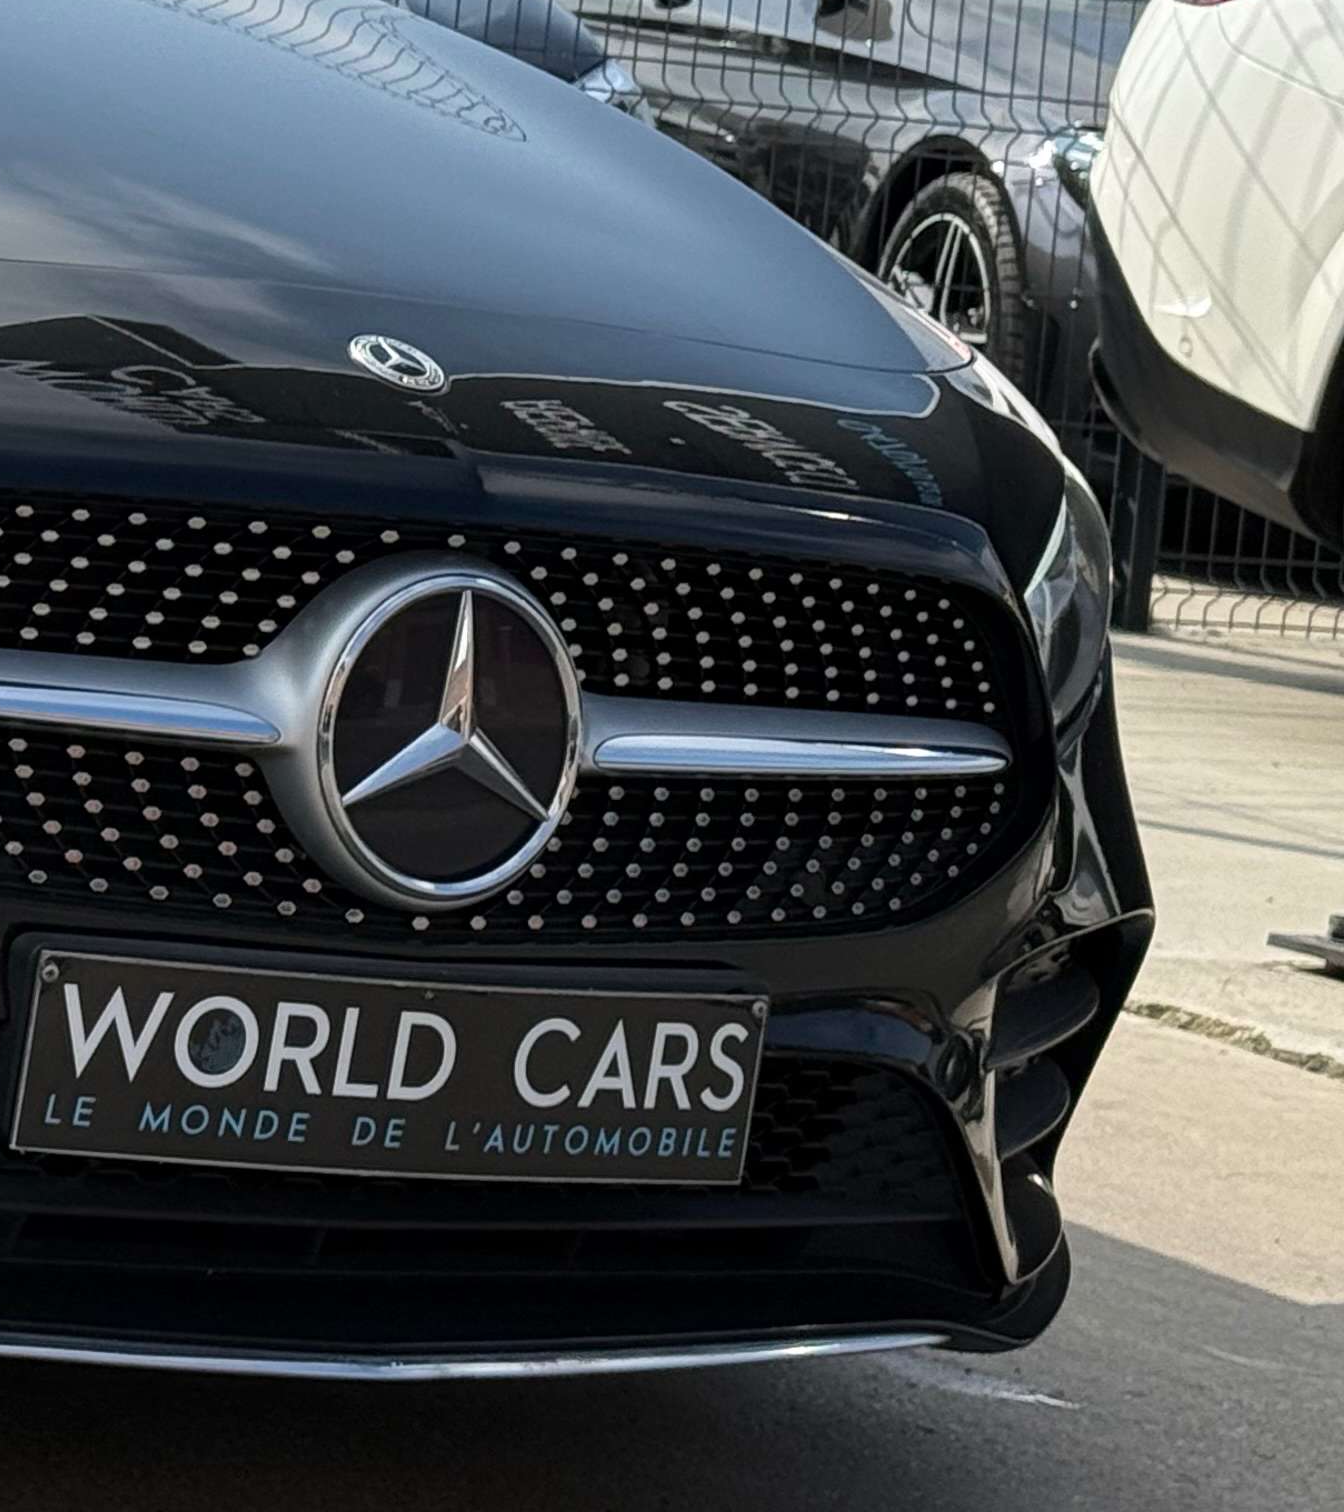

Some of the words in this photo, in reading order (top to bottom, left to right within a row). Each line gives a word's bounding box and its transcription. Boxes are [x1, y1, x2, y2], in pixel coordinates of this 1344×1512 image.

[63, 983, 457, 1101] WORLD
[514, 1017, 749, 1112] CARS
[44, 1094, 96, 1127] LE
[138, 1103, 311, 1144] MONDE
[351, 1117, 406, 1149] DE
[444, 1121, 738, 1159] L'AUTOMOBILE
